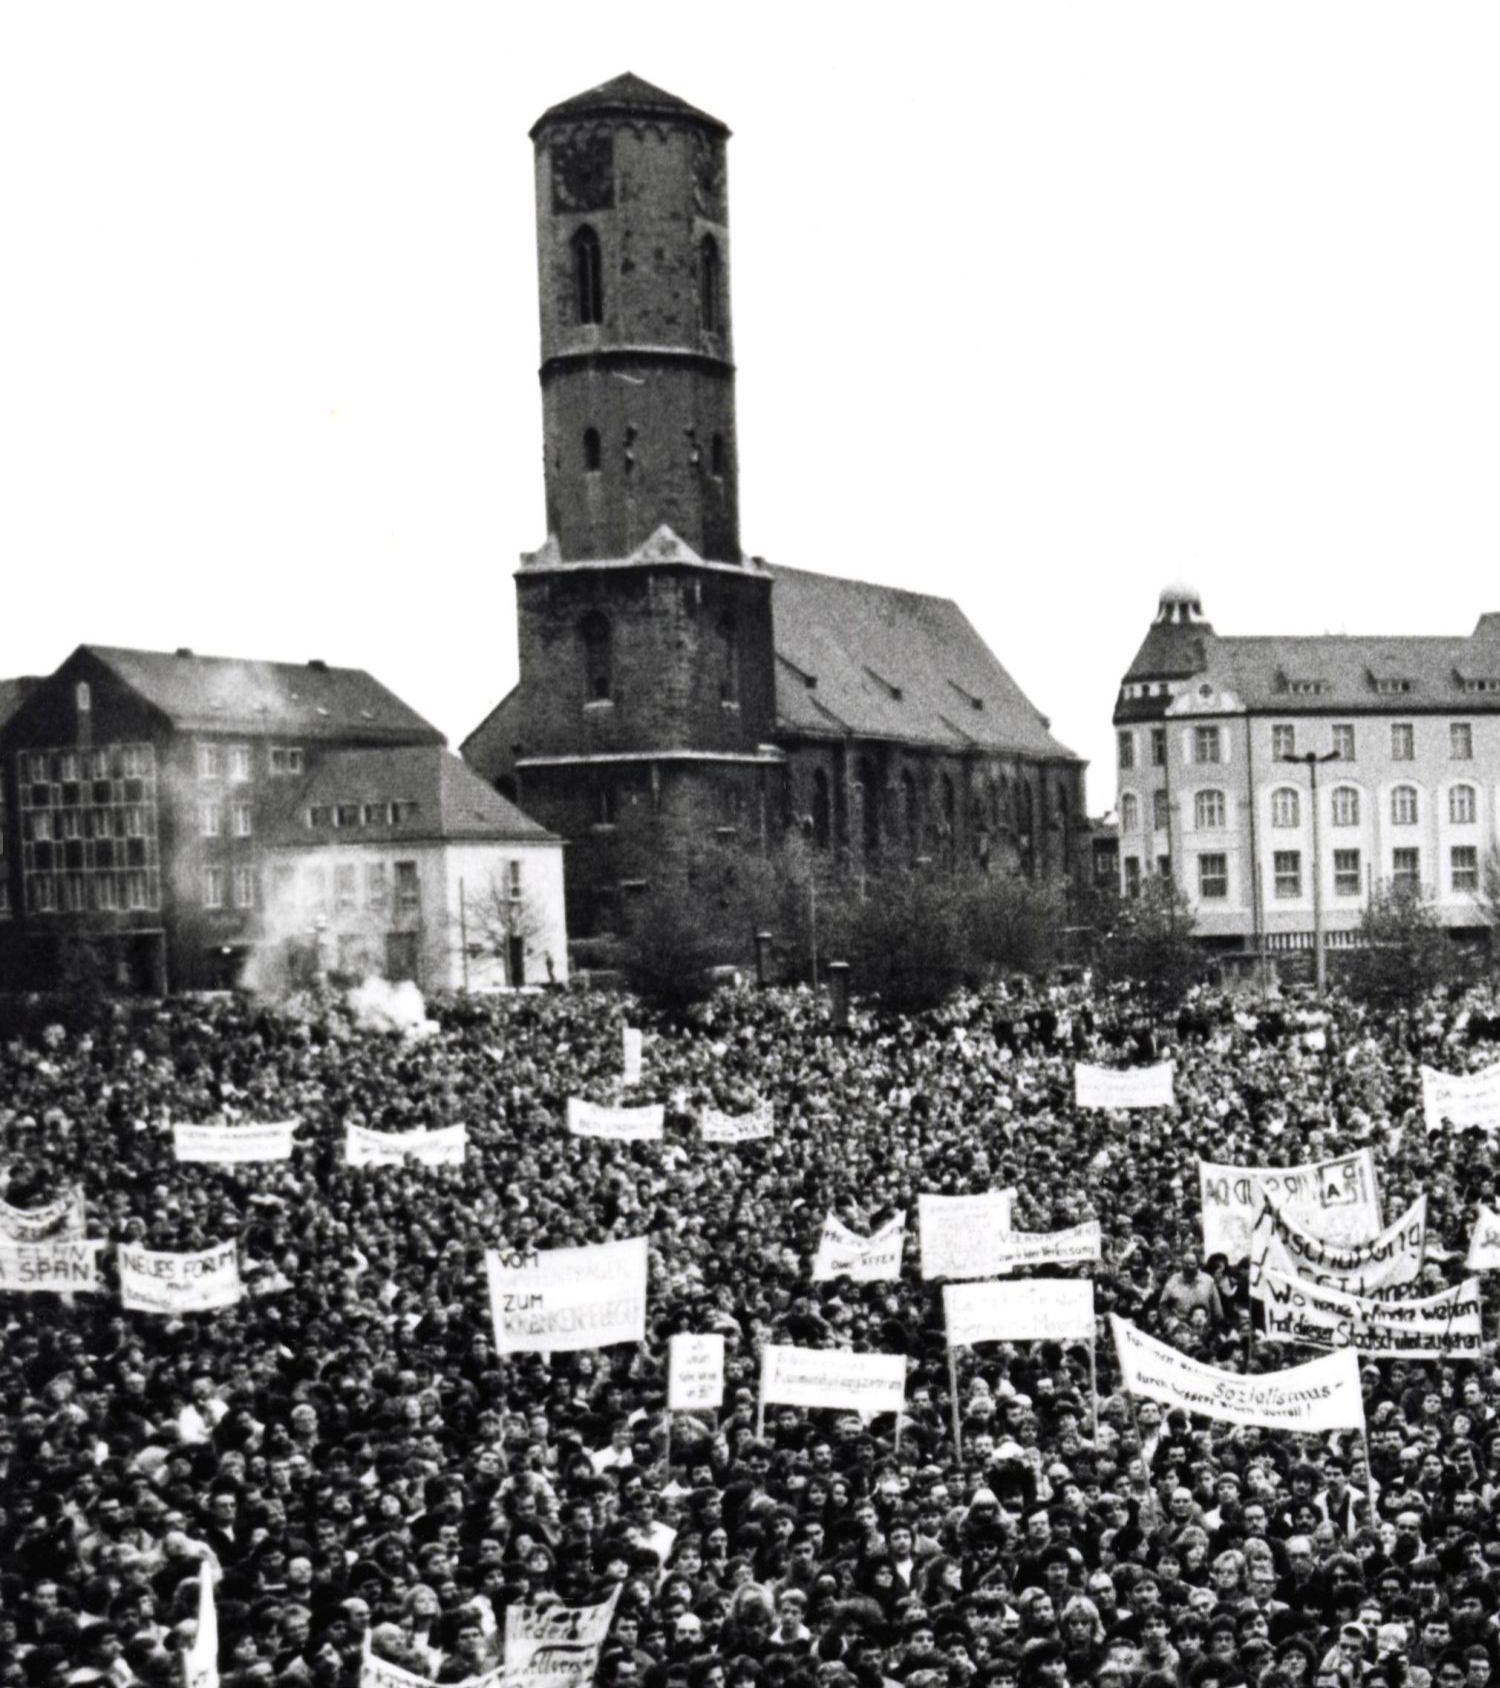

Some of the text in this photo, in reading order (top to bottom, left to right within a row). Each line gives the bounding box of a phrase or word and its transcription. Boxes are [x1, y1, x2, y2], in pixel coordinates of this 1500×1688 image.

[498, 1250, 539, 1270] VOM
[503, 1293, 544, 1313] ZUM
[1265, 1278, 1305, 1307] Wo
[1312, 1297, 1354, 1319] neue
[1355, 1300, 1413, 1324] Winde
[1269, 1308, 1293, 1334] hat
